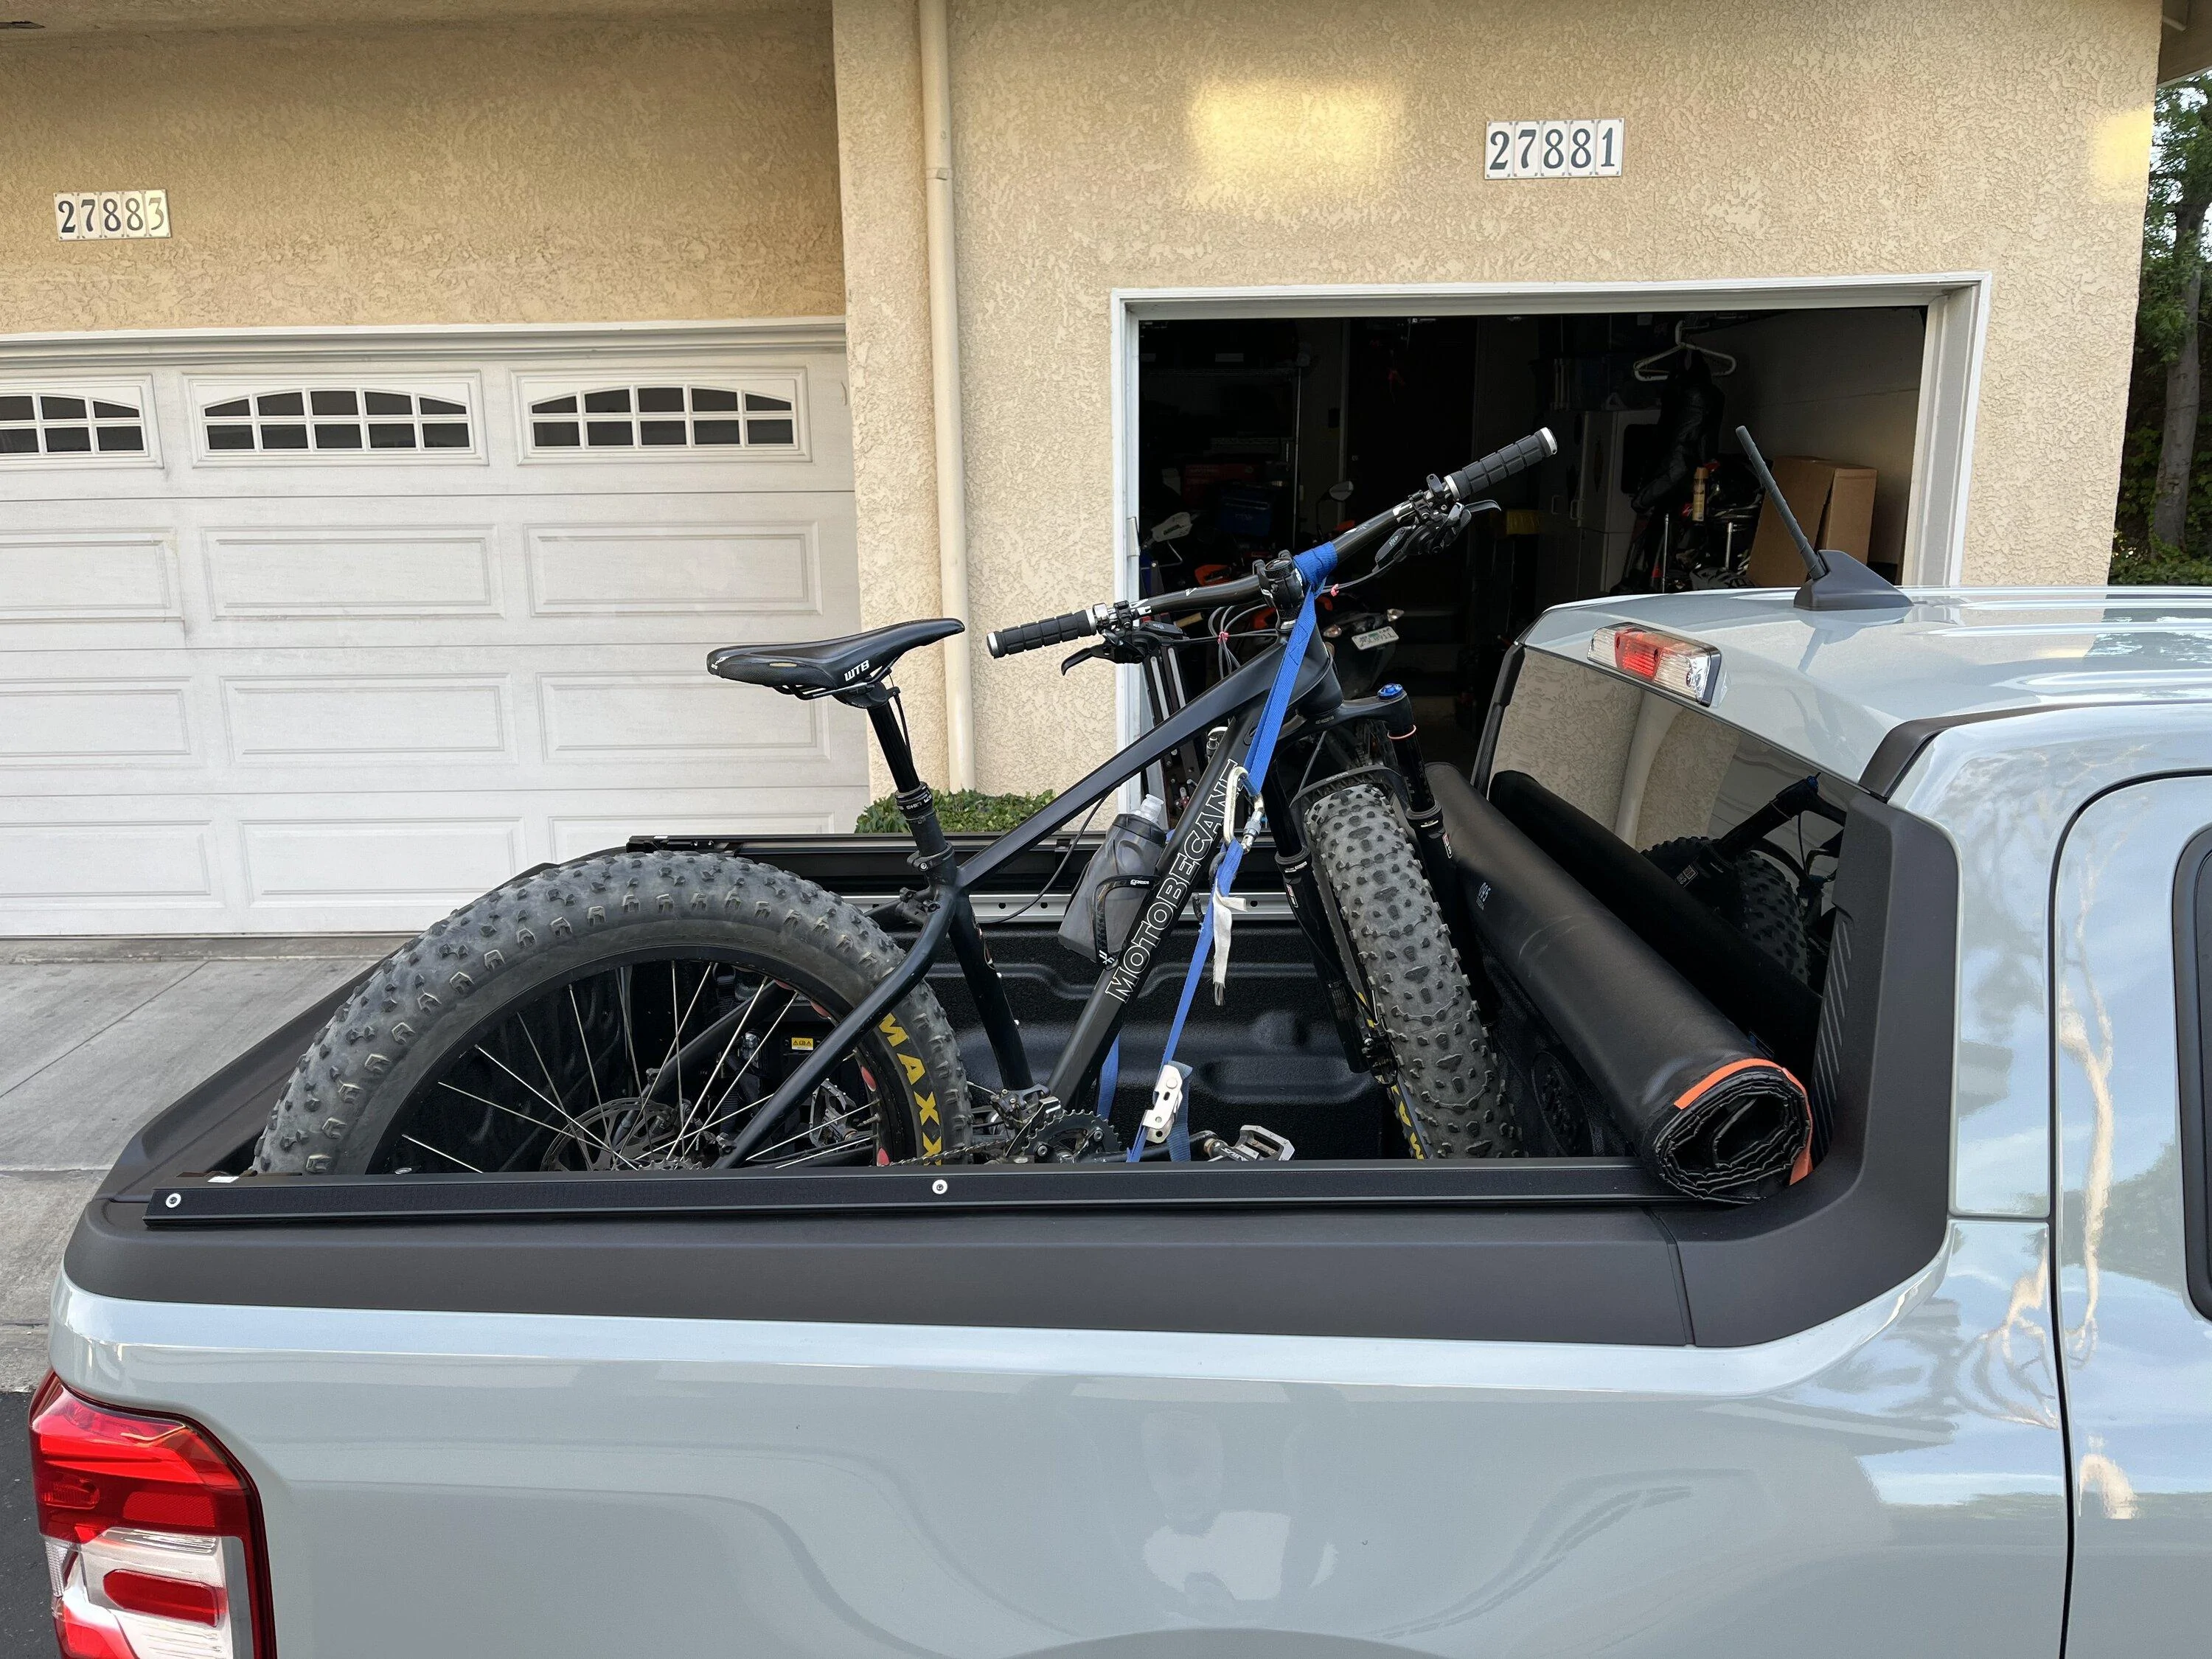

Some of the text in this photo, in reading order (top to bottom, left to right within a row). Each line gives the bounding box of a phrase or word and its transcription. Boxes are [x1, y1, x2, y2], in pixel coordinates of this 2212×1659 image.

[1489, 128, 1615, 170] 27881
[58, 197, 164, 233] 27883
[844, 660, 870, 682] WTB
